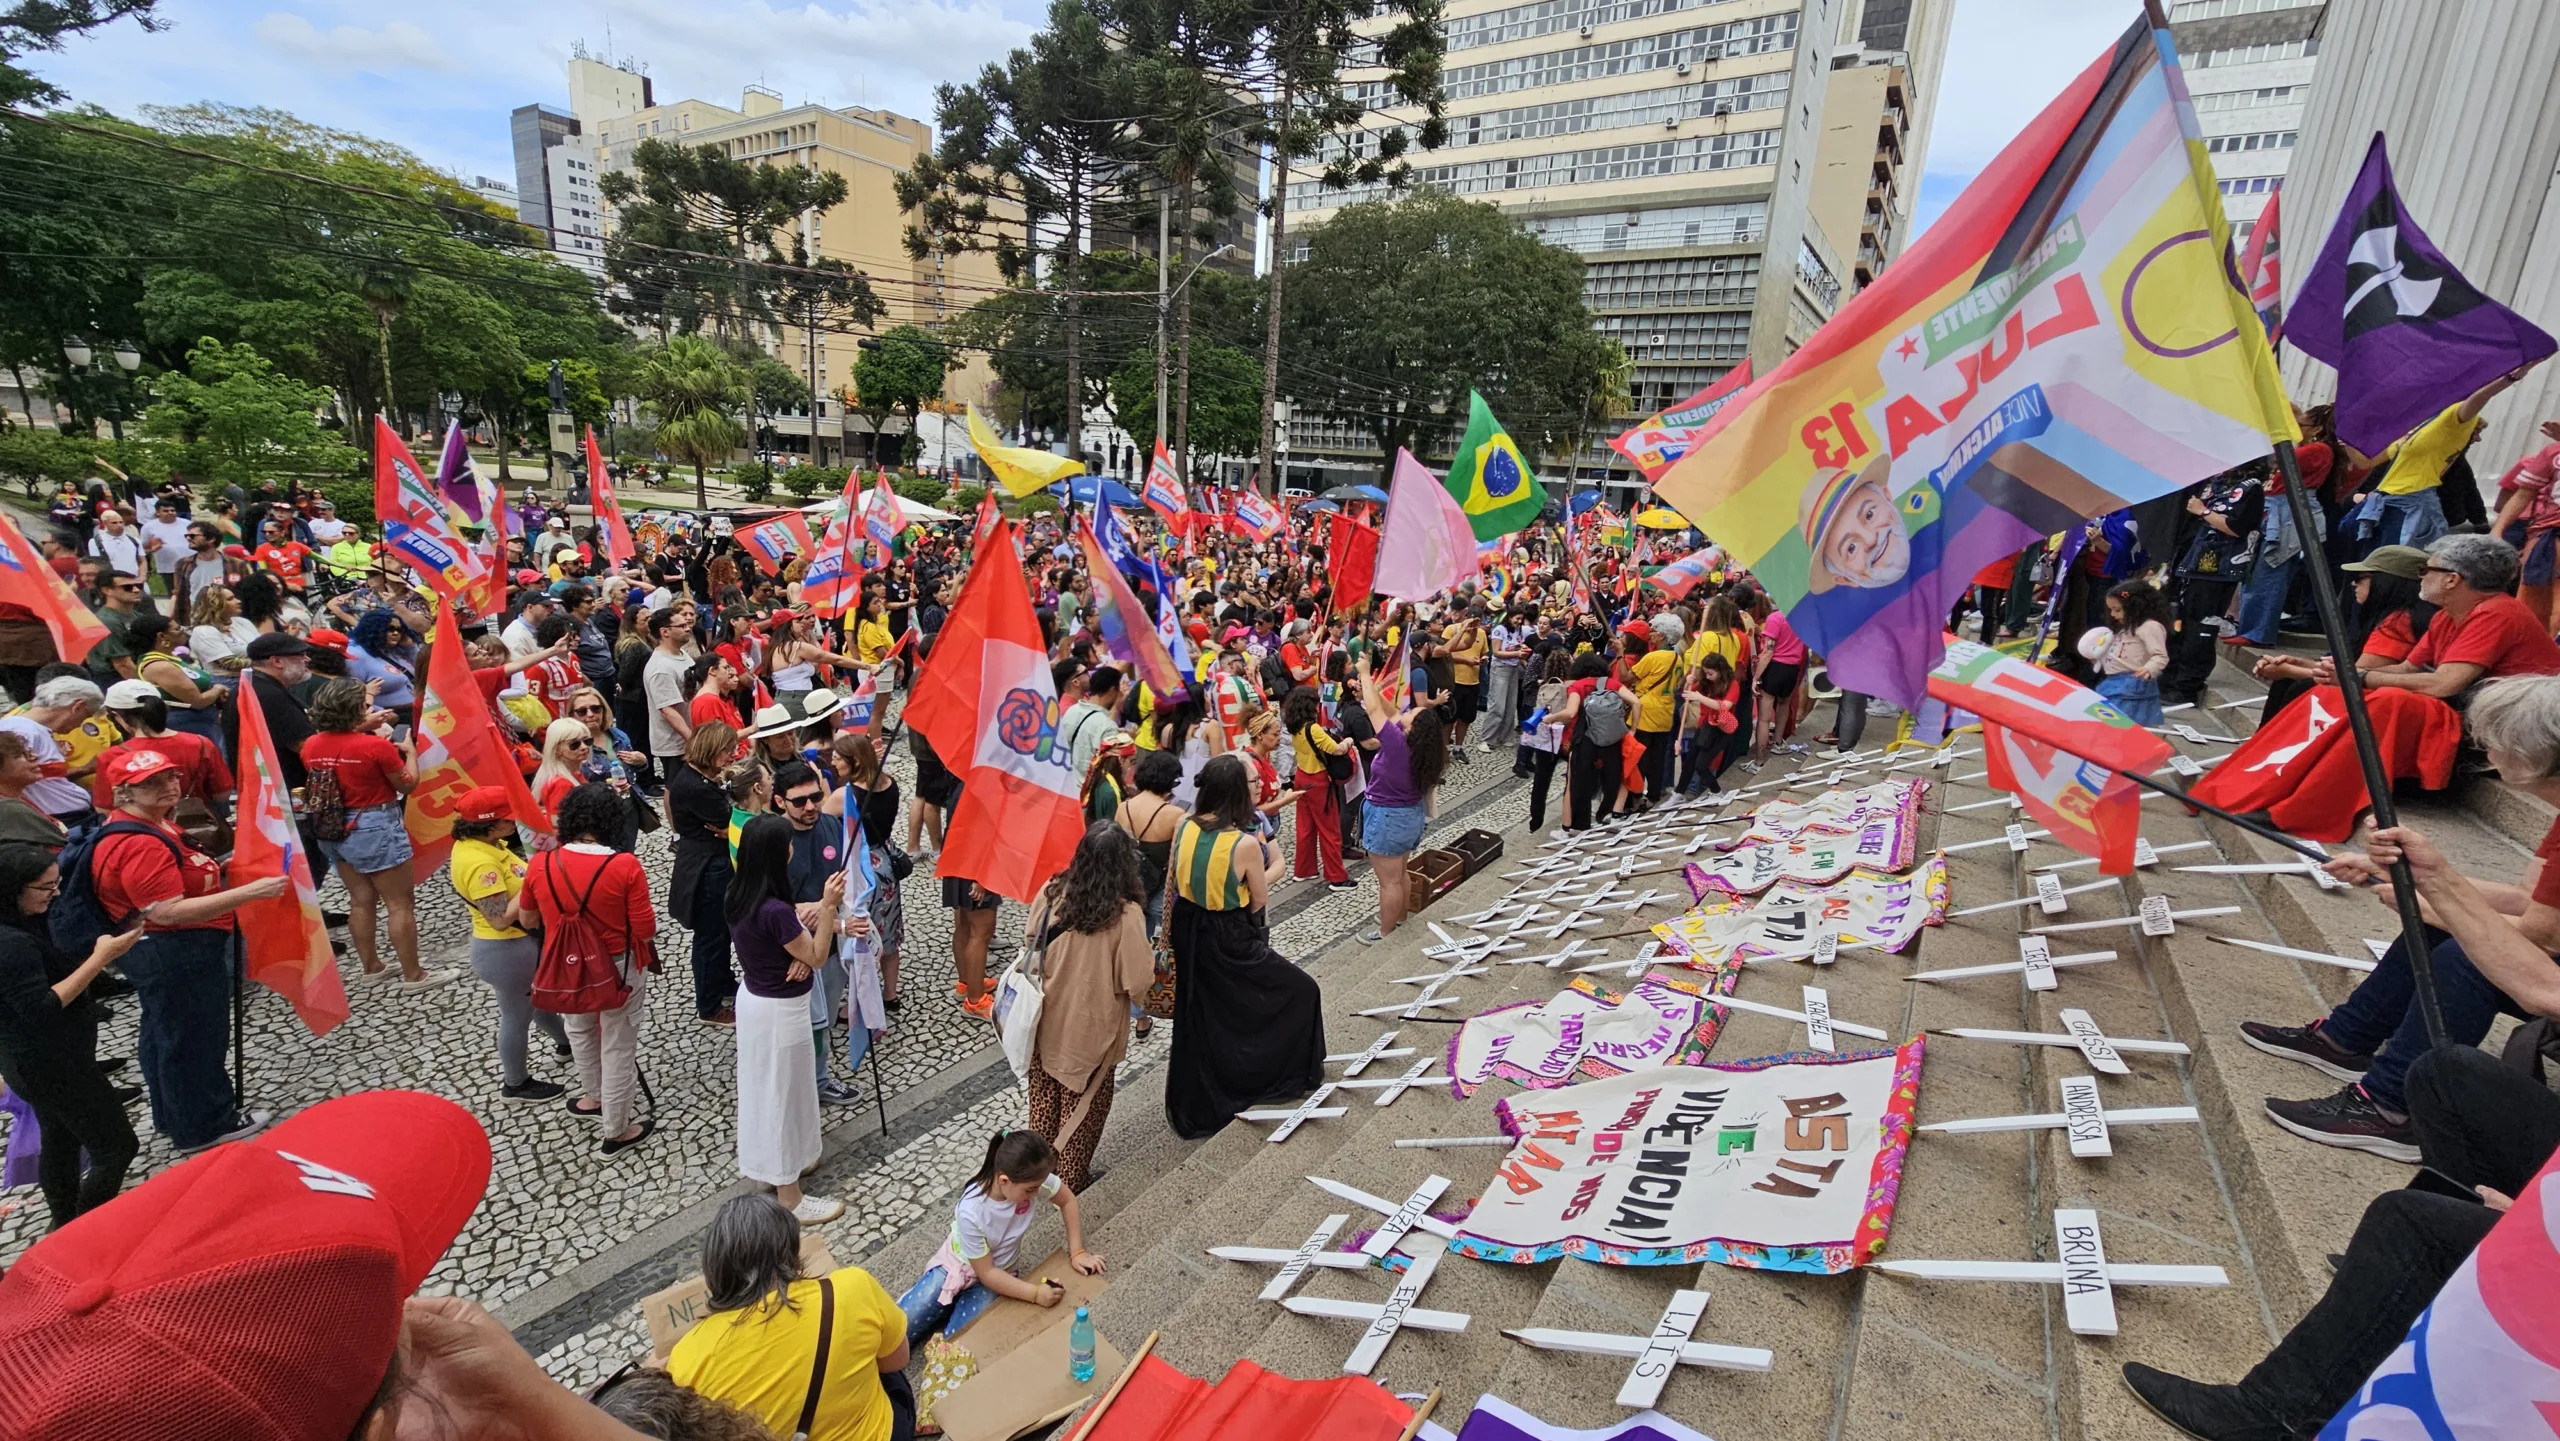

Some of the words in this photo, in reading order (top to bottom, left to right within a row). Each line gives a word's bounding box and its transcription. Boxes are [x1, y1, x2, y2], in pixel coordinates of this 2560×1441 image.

[478, 811, 495, 819] MST
[1866, 879, 1913, 938] ERES
[2021, 946, 2046, 974] IRIA
[1808, 999, 1832, 1038] RACHEL
[2070, 1019, 2117, 1062] GASSI
[2065, 1083, 2105, 1146] ANDRESSA
[1586, 1132, 1624, 1167] DE
[2060, 1224, 2106, 1297] BRUNA
[1633, 1308, 1698, 1382] LAÍS
